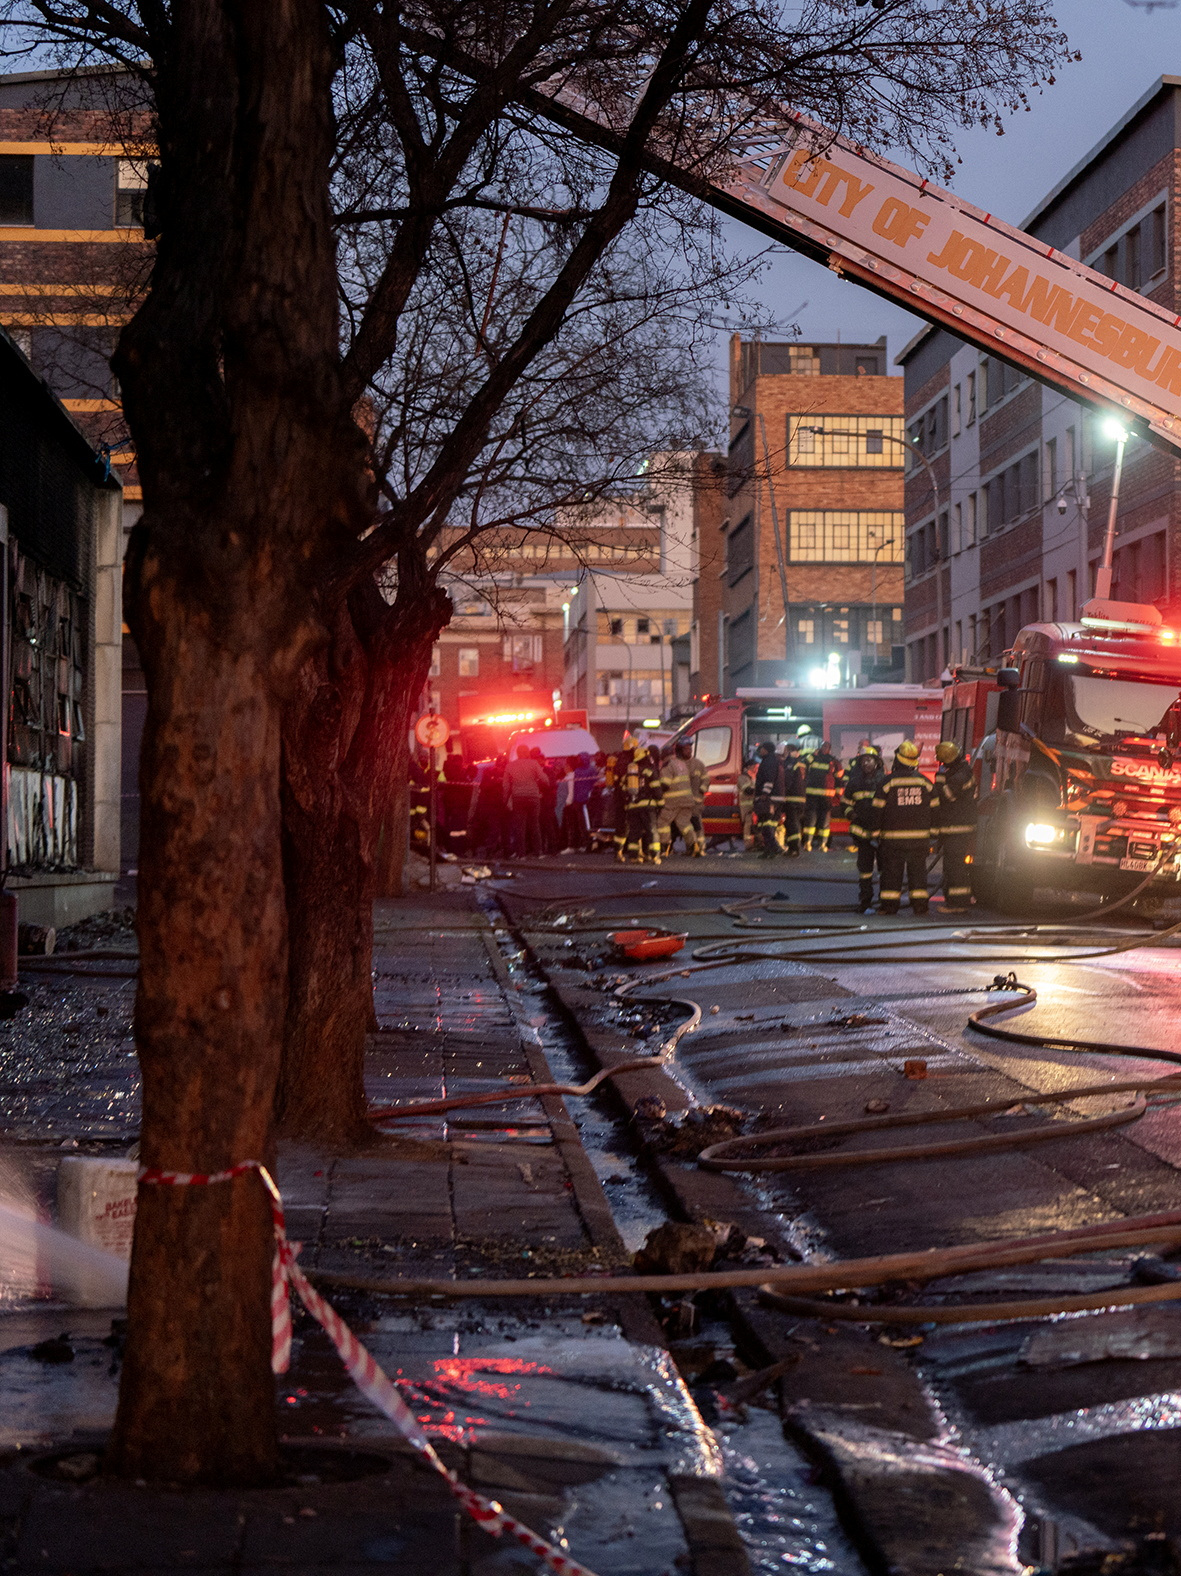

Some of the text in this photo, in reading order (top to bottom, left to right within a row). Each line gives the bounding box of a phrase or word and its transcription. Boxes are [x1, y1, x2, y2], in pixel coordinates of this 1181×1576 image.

[783, 149, 875, 218] CITY
[872, 197, 931, 248] OF
[897, 796, 922, 806] EMS
